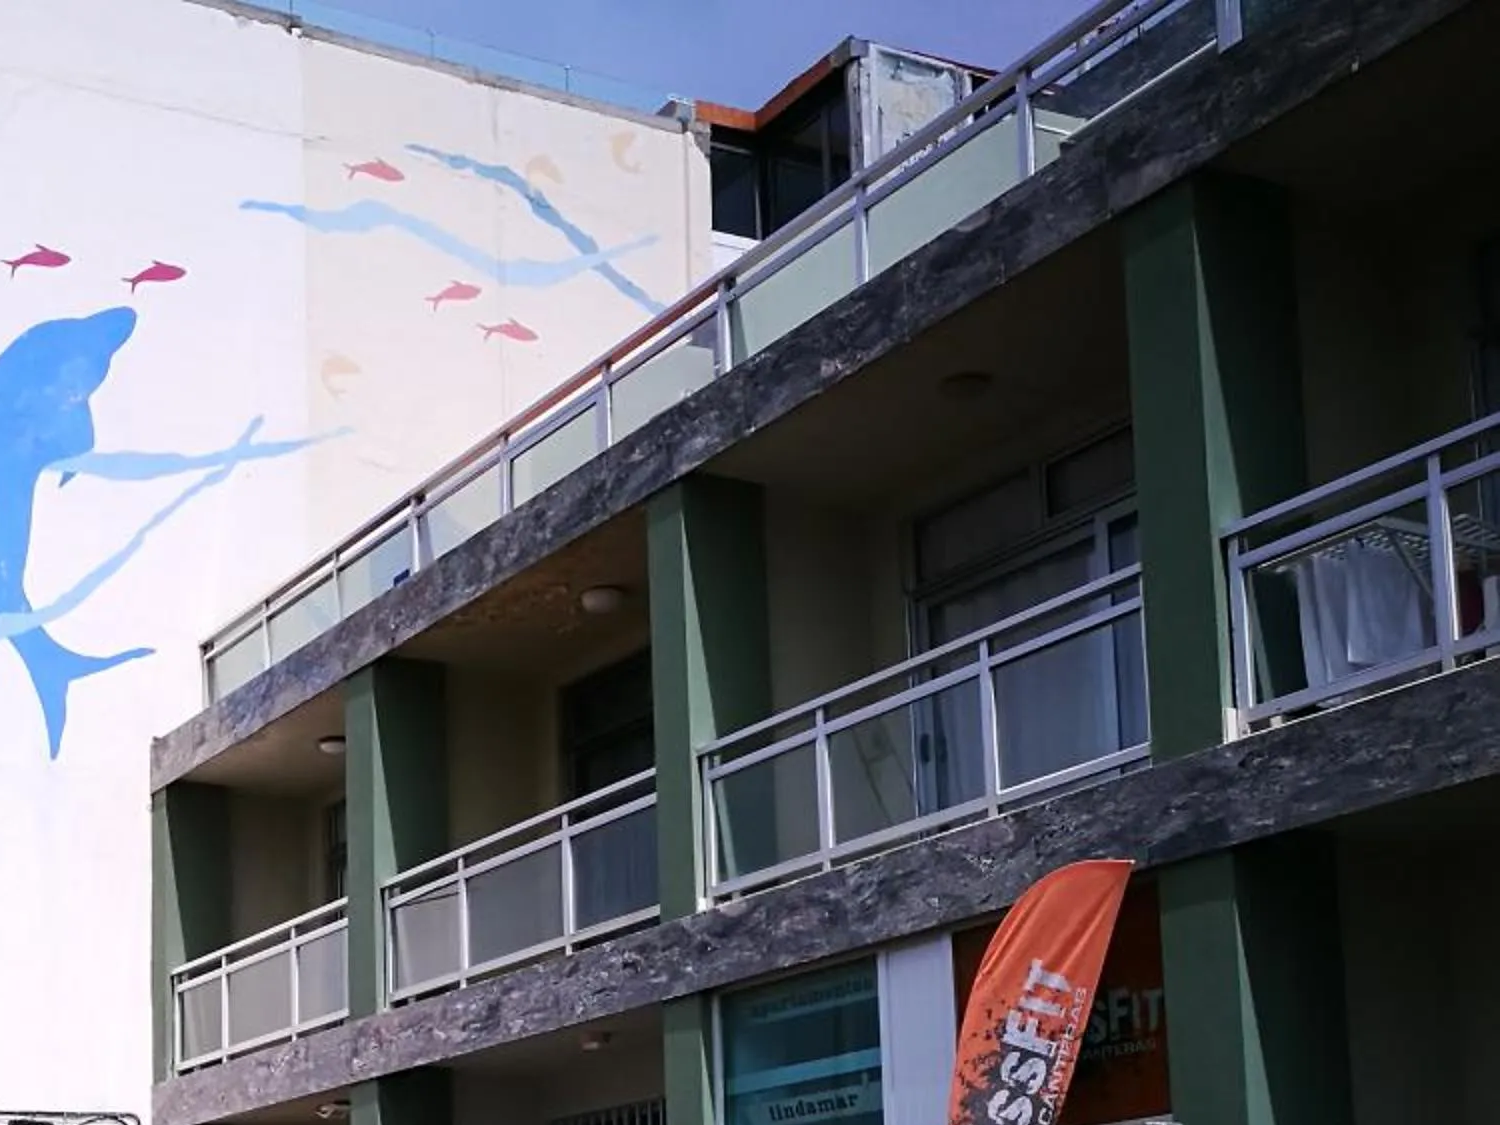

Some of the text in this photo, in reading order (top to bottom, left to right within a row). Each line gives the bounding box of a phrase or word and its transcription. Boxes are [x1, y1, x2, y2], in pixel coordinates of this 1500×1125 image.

[1087, 987, 1163, 1045] SFIT
[1082, 1037, 1157, 1061] ANTERAS
[768, 1093, 859, 1122] lindamar
